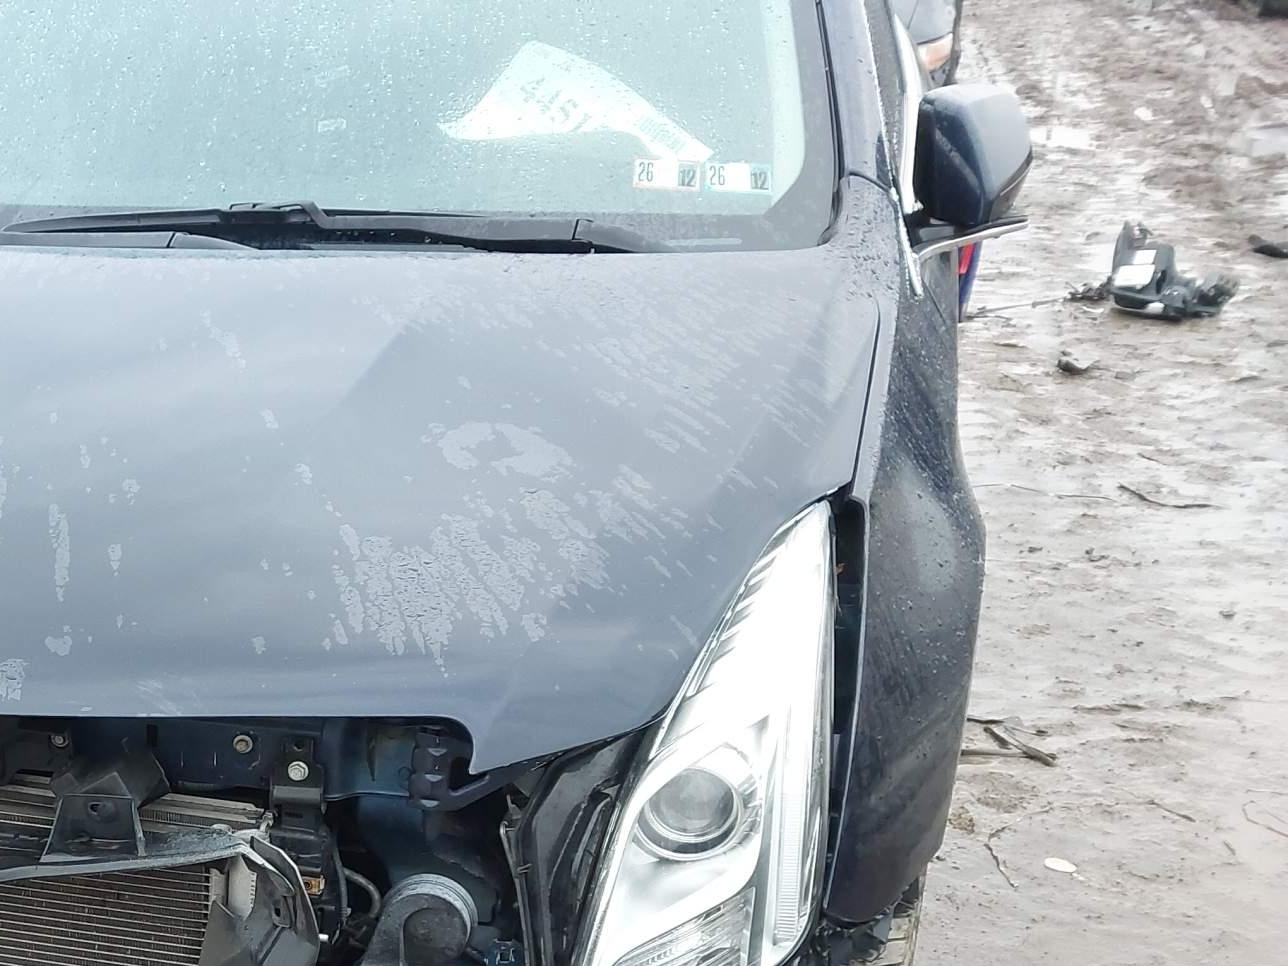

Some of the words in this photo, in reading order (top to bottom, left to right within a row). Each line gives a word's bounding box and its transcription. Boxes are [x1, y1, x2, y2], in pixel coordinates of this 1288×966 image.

[637, 161, 655, 183] 26
[679, 168, 697, 188] 12
[709, 165, 726, 186] 26
[751, 171, 769, 191] 12
